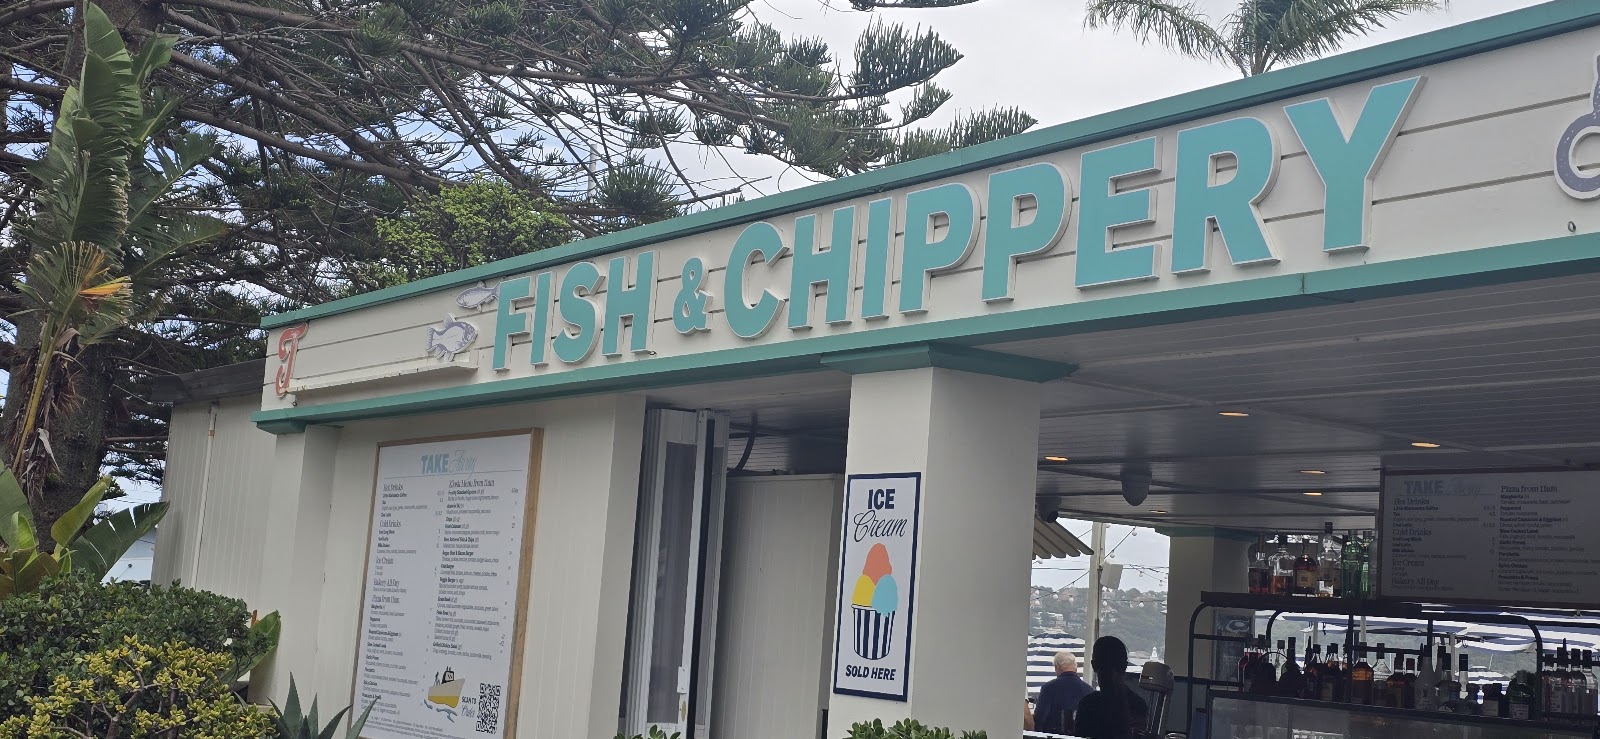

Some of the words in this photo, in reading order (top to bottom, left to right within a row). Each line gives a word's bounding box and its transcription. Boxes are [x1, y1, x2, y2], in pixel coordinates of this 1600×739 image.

[492, 250, 659, 372] FISH
[673, 257, 712, 335] &
[724, 75, 1429, 340] CHIPPERY
[421, 453, 450, 474] TAKE
[449, 449, 478, 480] Away
[1404, 480, 1444, 494] TAKE
[867, 488, 896, 510] ICE
[853, 510, 908, 542] Cream
[845, 664, 870, 680] SOLD
[870, 667, 896, 681] HERE
[462, 696, 472, 704] SCAN
